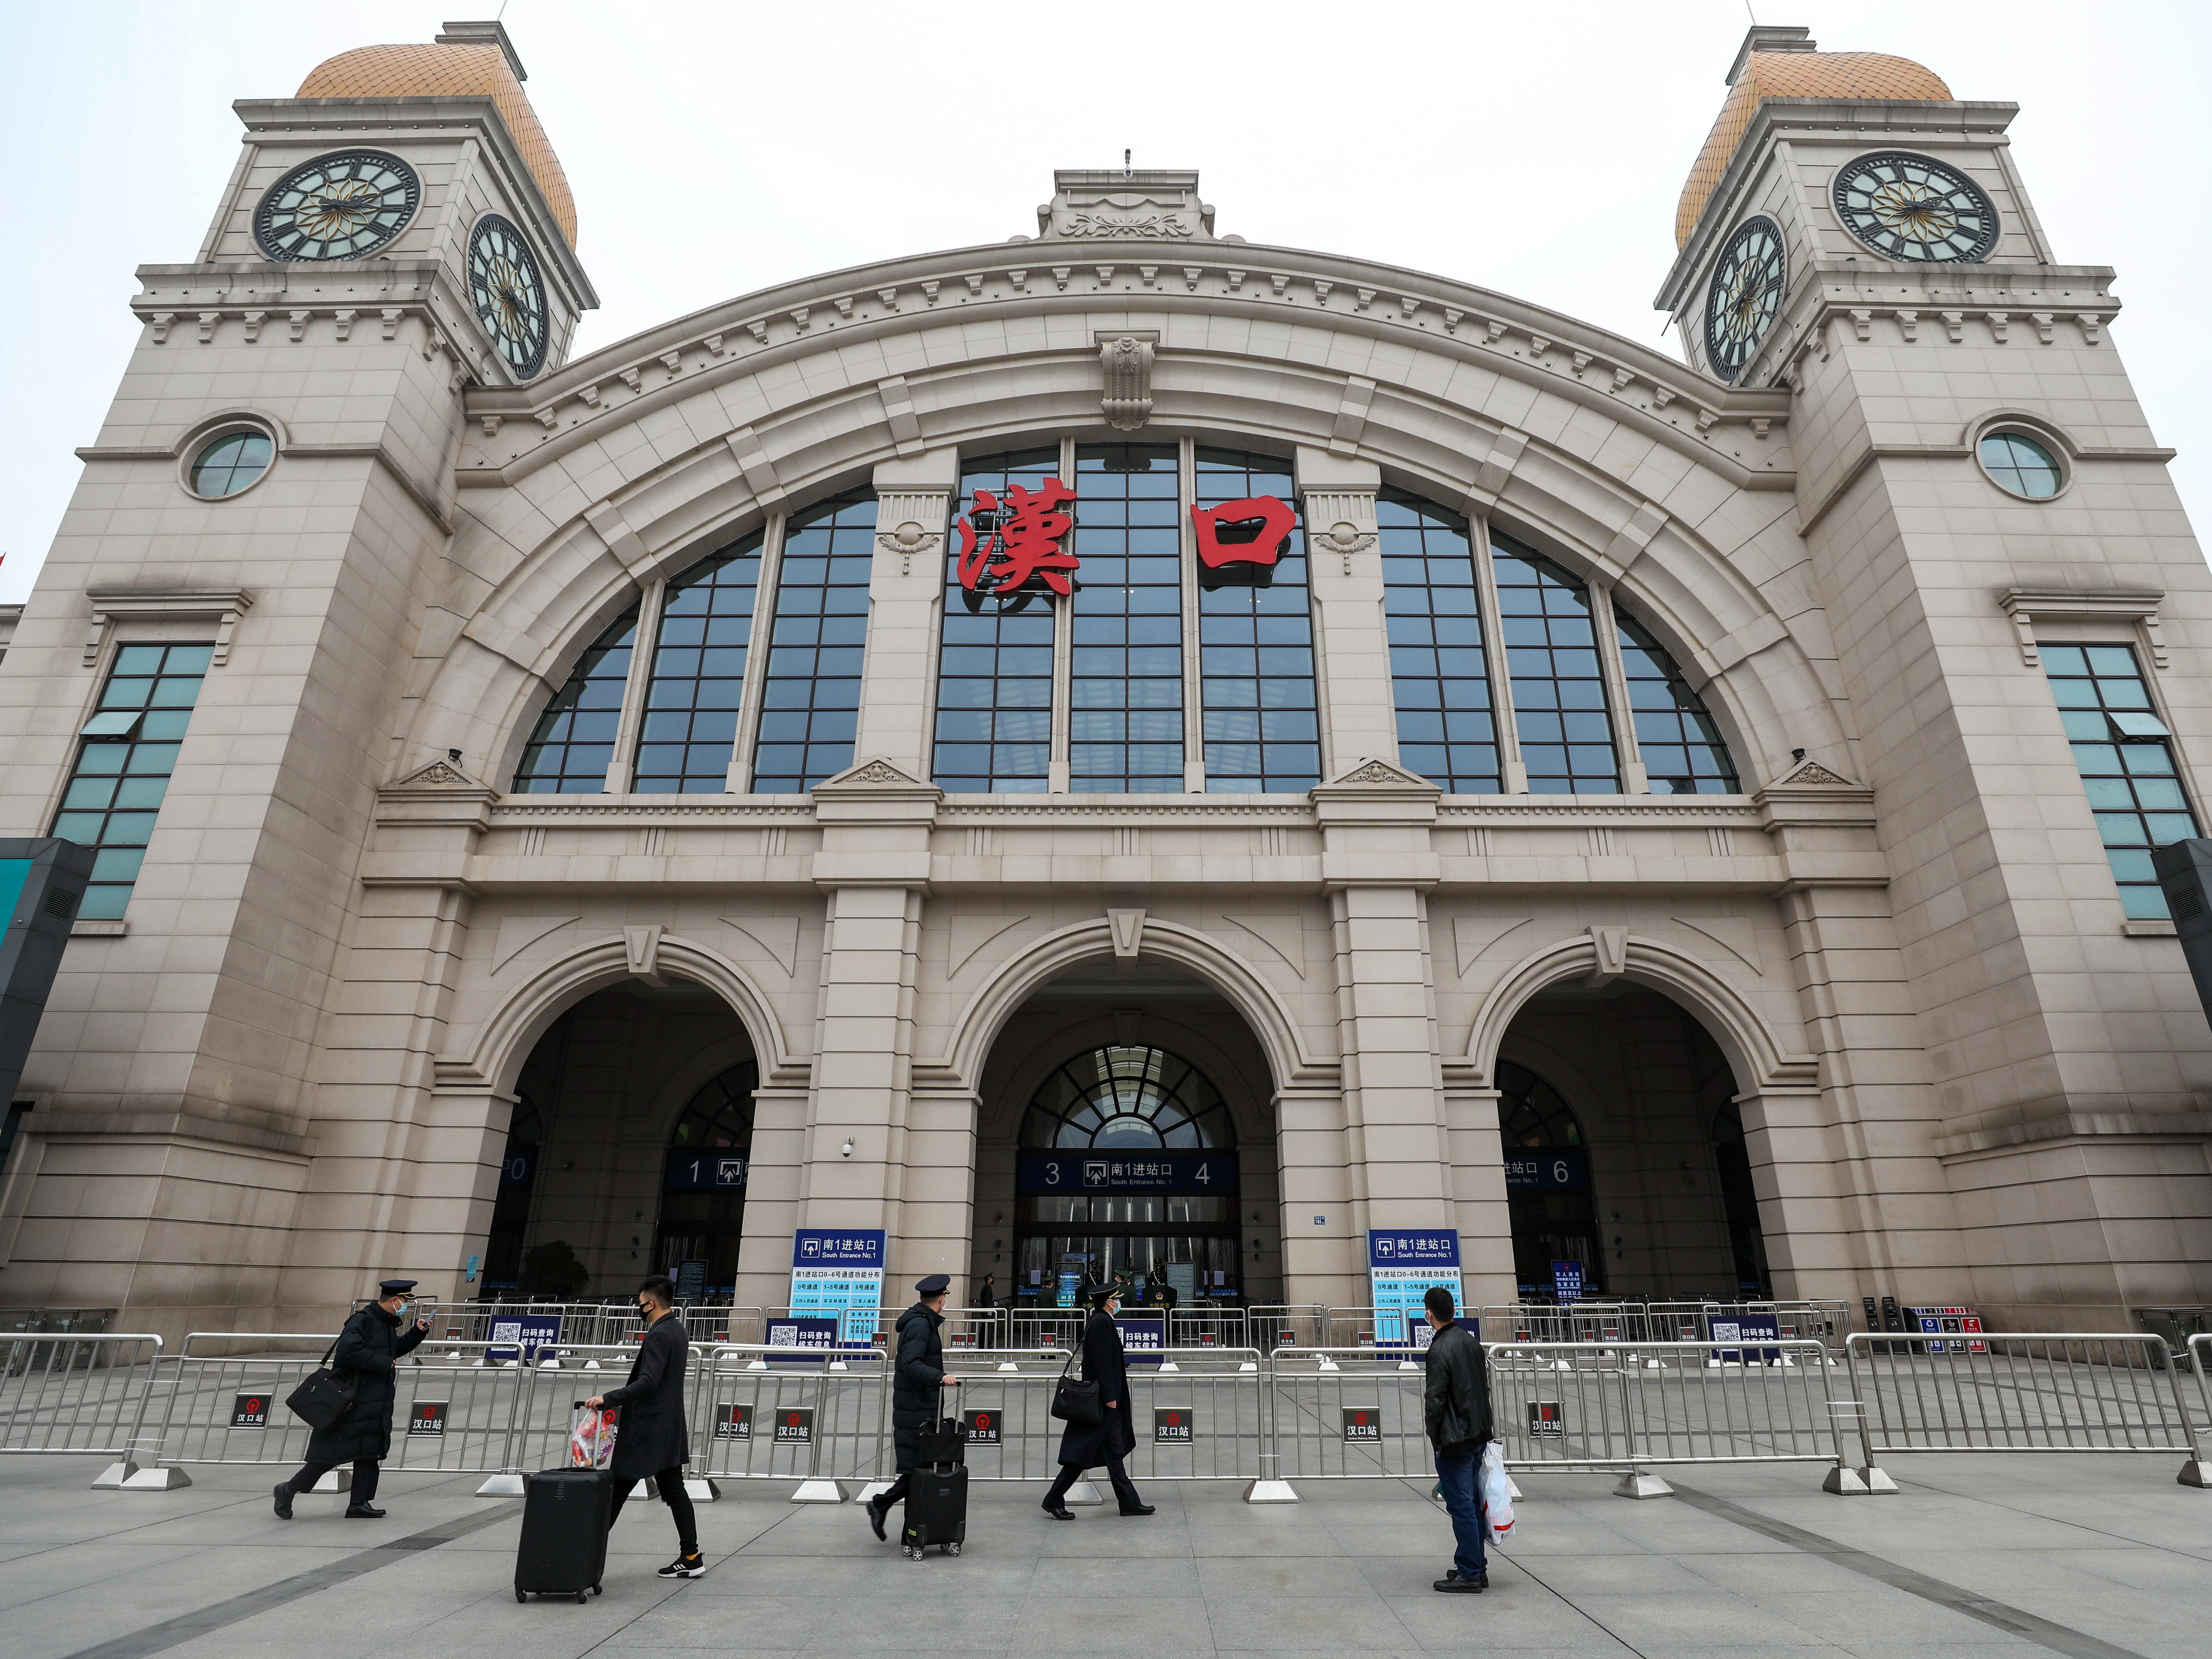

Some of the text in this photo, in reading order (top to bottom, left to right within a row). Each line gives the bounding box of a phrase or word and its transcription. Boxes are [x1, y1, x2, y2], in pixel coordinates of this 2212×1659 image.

[511, 1158, 525, 1179] 0
[690, 1160, 699, 1182] 1
[1045, 1162, 1060, 1185] 3
[1111, 1162, 1172, 1176] 南1进站口
[1195, 1162, 1210, 1185] 4
[1554, 1161, 1569, 1183] 6
[823, 1239, 876, 1251] 南1进站口
[1397, 1238, 1450, 1250] 南1进站口
[522, 1328, 554, 1337] 扫码查询
[799, 1331, 831, 1340] 扫码查询
[1126, 1332, 1158, 1341] 扫码查询
[1741, 1328, 1774, 1337] 扫码查询
[237, 1414, 264, 1422] 汉口站
[413, 1419, 442, 1430] 汉口站
[719, 1421, 749, 1433] 汉口站
[778, 1426, 808, 1437] 汉口站
[969, 1430, 997, 1438] 汉口站
[1159, 1426, 1189, 1437] 汉口站
[1347, 1425, 1377, 1436] 汉口站
